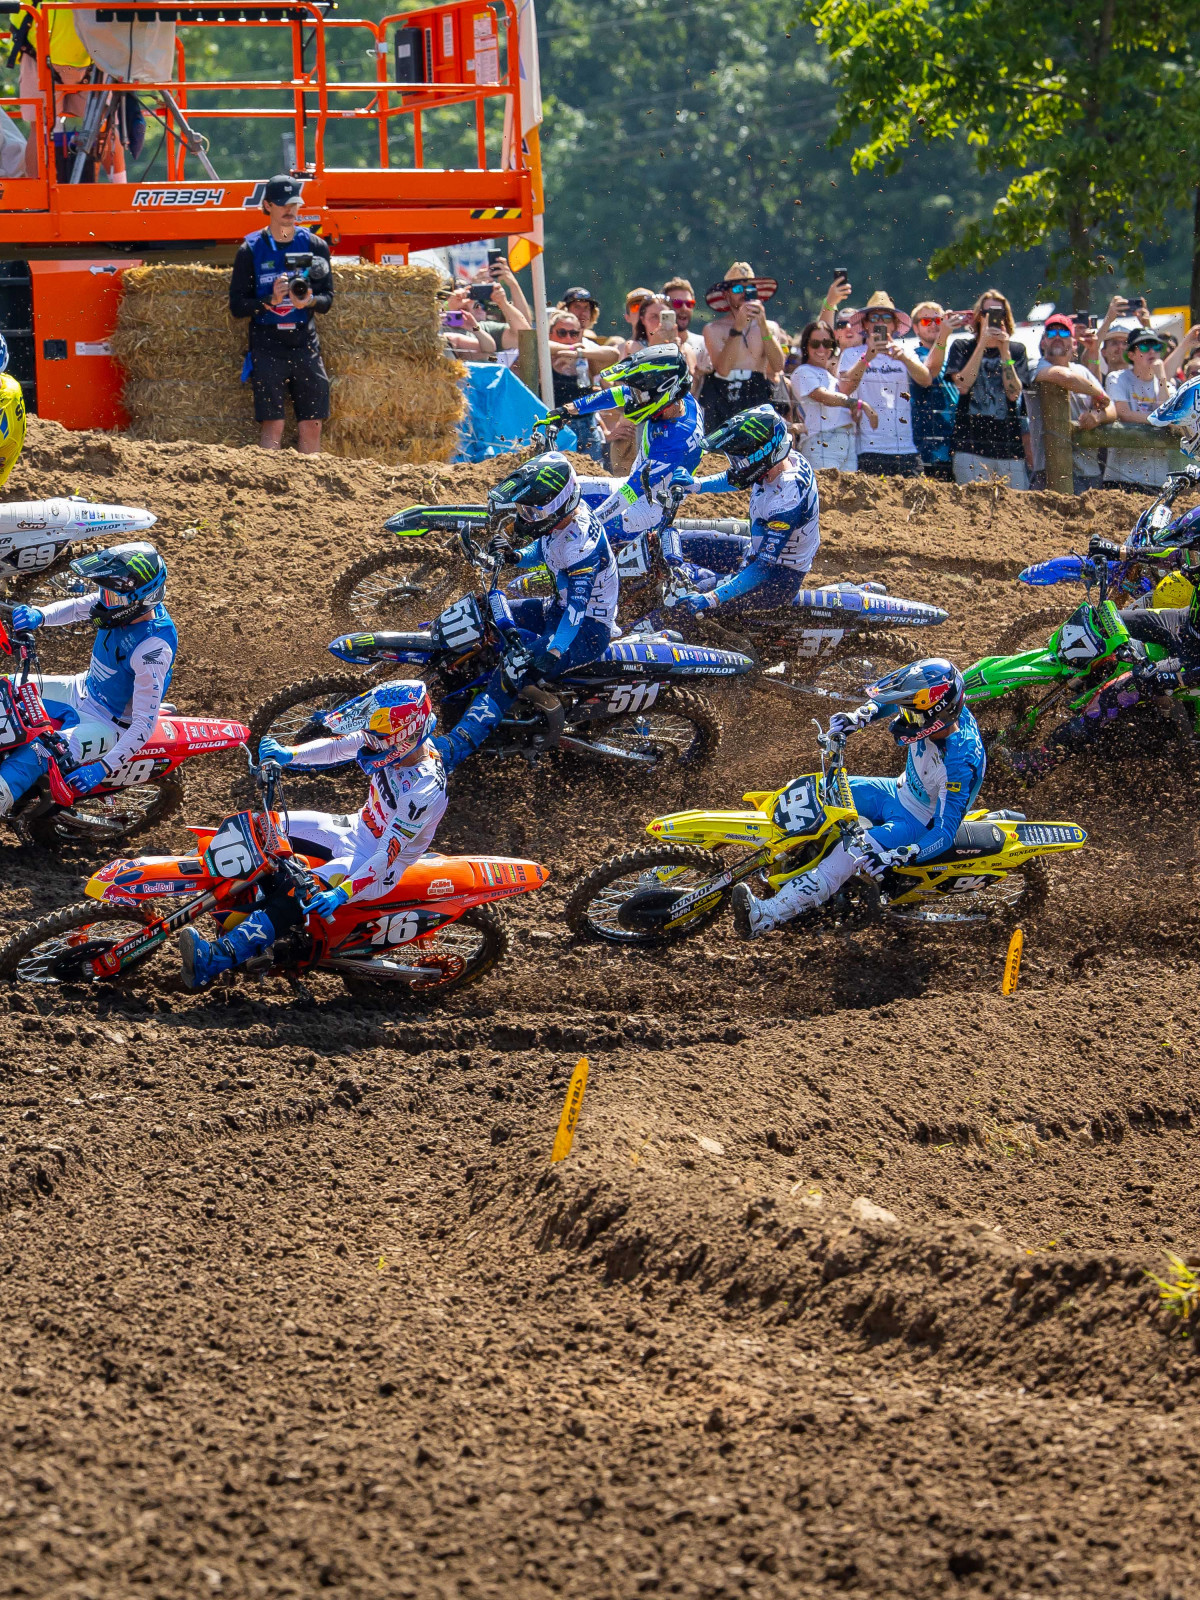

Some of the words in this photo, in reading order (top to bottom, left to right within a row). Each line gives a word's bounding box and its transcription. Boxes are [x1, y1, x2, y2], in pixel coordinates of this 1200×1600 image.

[132, 189, 225, 206] RT3394
[748, 431, 783, 464] 100%
[84, 523, 121, 534] DUNLOP
[17, 543, 56, 569] 69
[441, 597, 481, 648] 511
[797, 628, 845, 657] 37
[622, 663, 644, 672] YAMAA
[1156, 672, 1176, 682] FOX
[20, 687, 38, 723] RENTHAL
[26, 685, 43, 720] RENTHAL
[607, 682, 661, 714] 511
[927, 699, 949, 717] FOX
[187, 739, 228, 750] DUNLOP
[103, 758, 156, 787] 48
[779, 786, 816, 835] 94
[209, 821, 252, 878] 16
[1008, 847, 1040, 858] DUNLOP
[490, 887, 526, 898] DUNLOP
[366, 911, 420, 945] 16
[566, 1078, 583, 1134] ACERBIS
